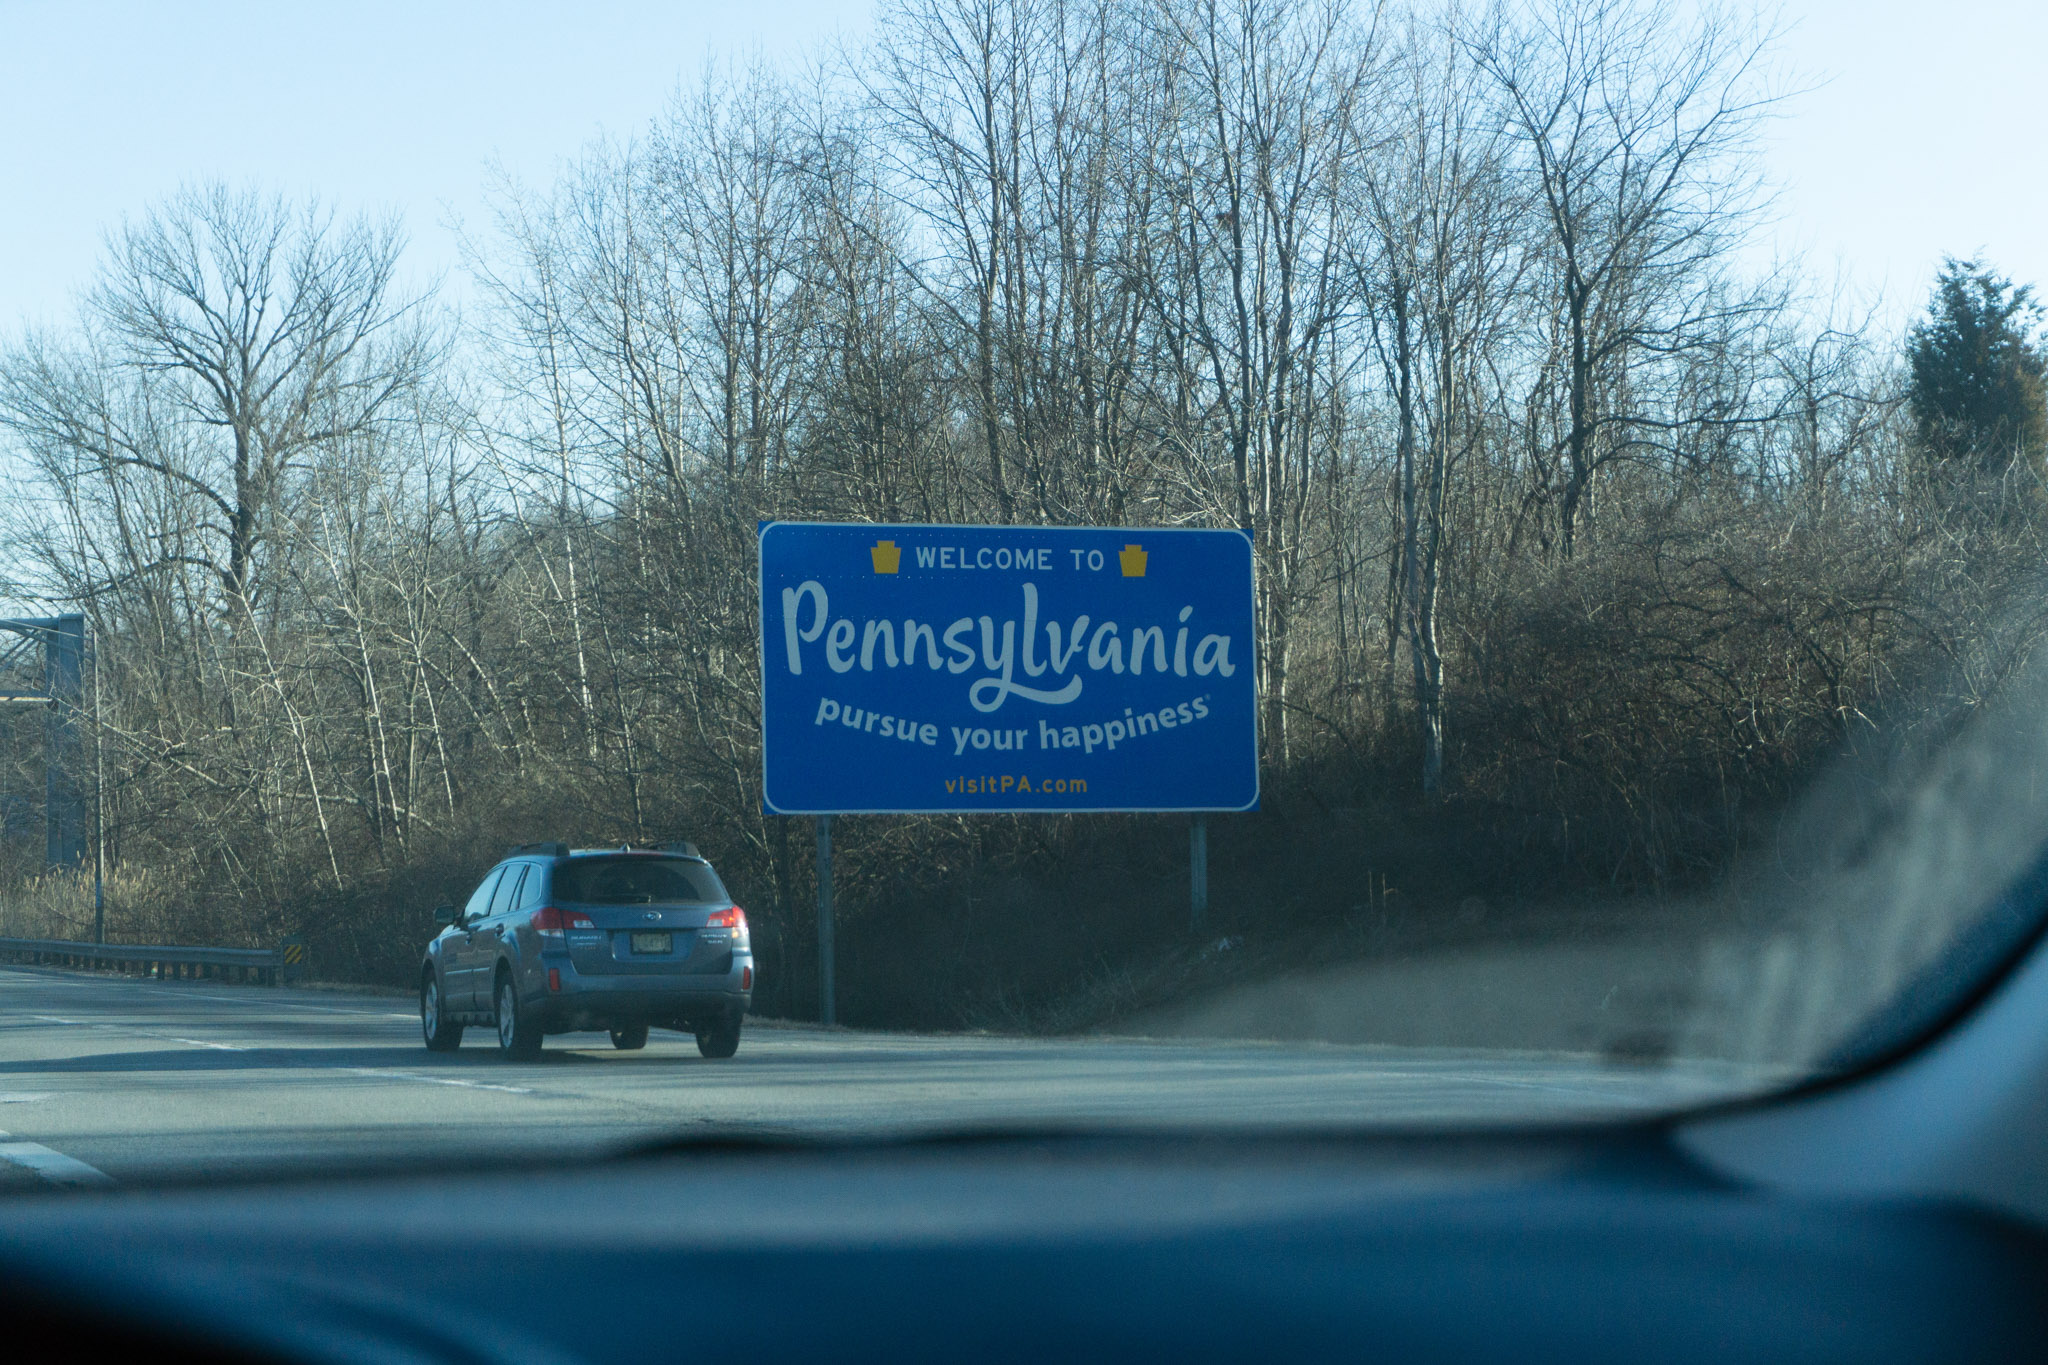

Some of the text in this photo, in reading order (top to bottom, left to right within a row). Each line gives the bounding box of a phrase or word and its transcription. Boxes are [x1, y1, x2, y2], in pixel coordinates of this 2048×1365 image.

[915, 546, 1104, 571] WELCOME TO
[782, 580, 1236, 713] Pennsylvania
[814, 697, 1209, 756] pursue your happiness
[944, 775, 1089, 794] visitPA.com
